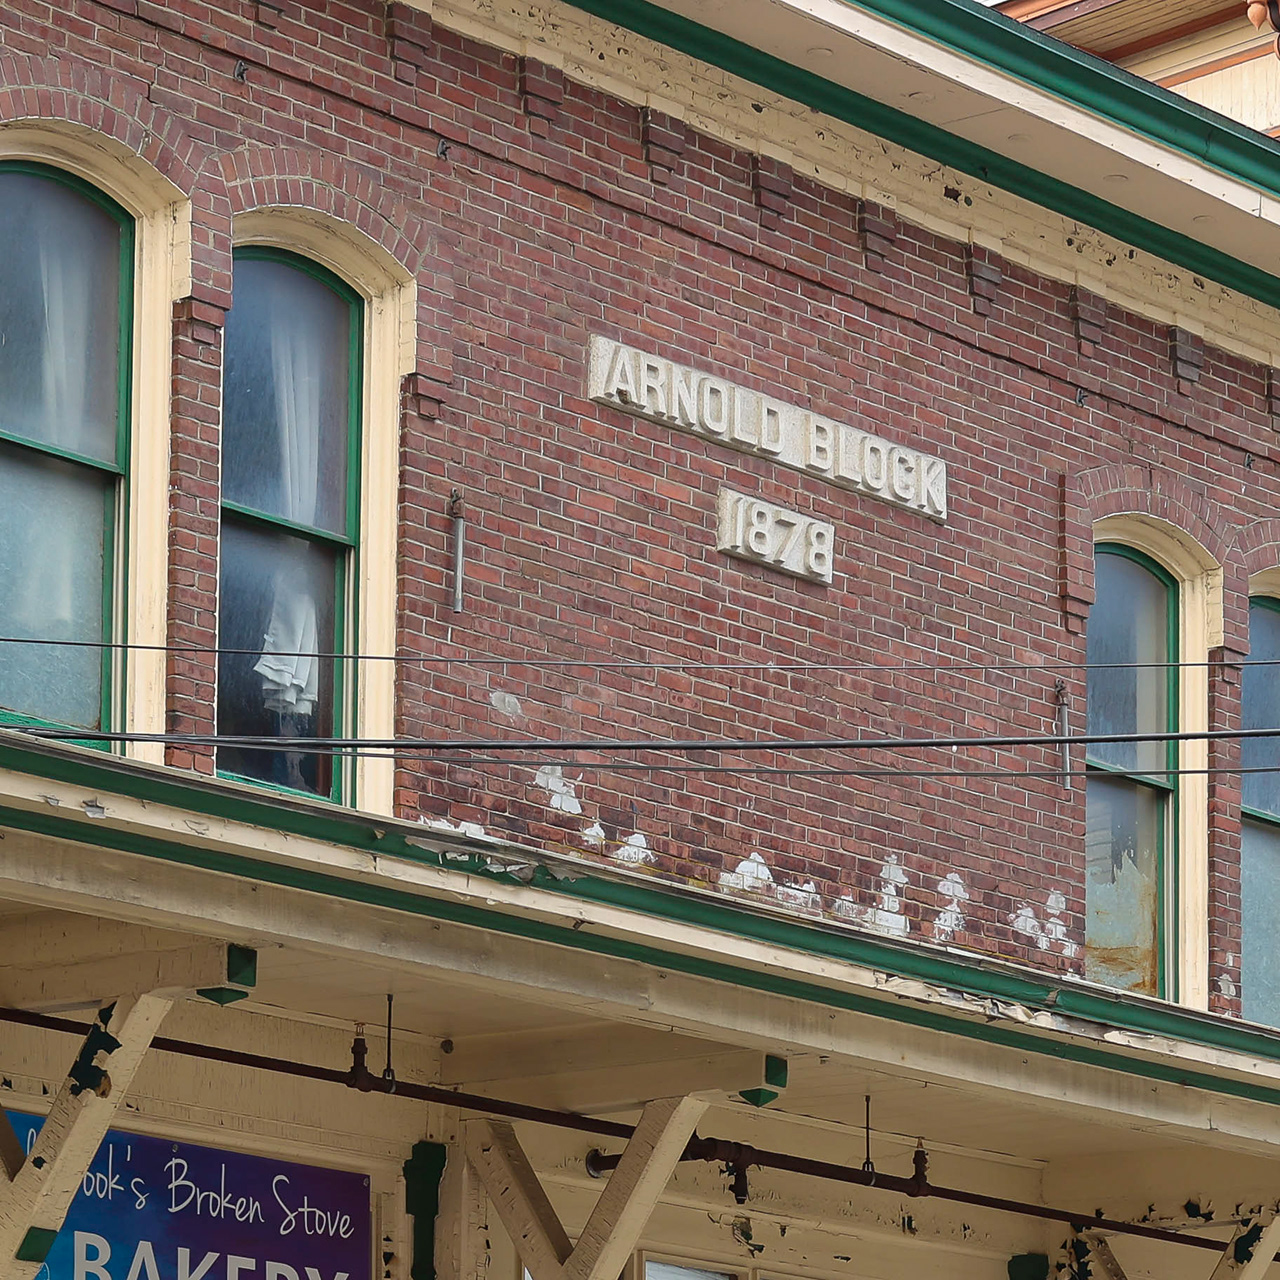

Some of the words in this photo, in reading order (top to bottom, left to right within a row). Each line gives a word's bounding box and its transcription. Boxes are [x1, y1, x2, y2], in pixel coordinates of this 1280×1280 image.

[604, 345, 786, 455] ARNOLD
[805, 414, 944, 516] BLOCK
[729, 496, 833, 577] 1878
[164, 1157, 265, 1223] Broken
[272, 1174, 355, 1239] Stove
